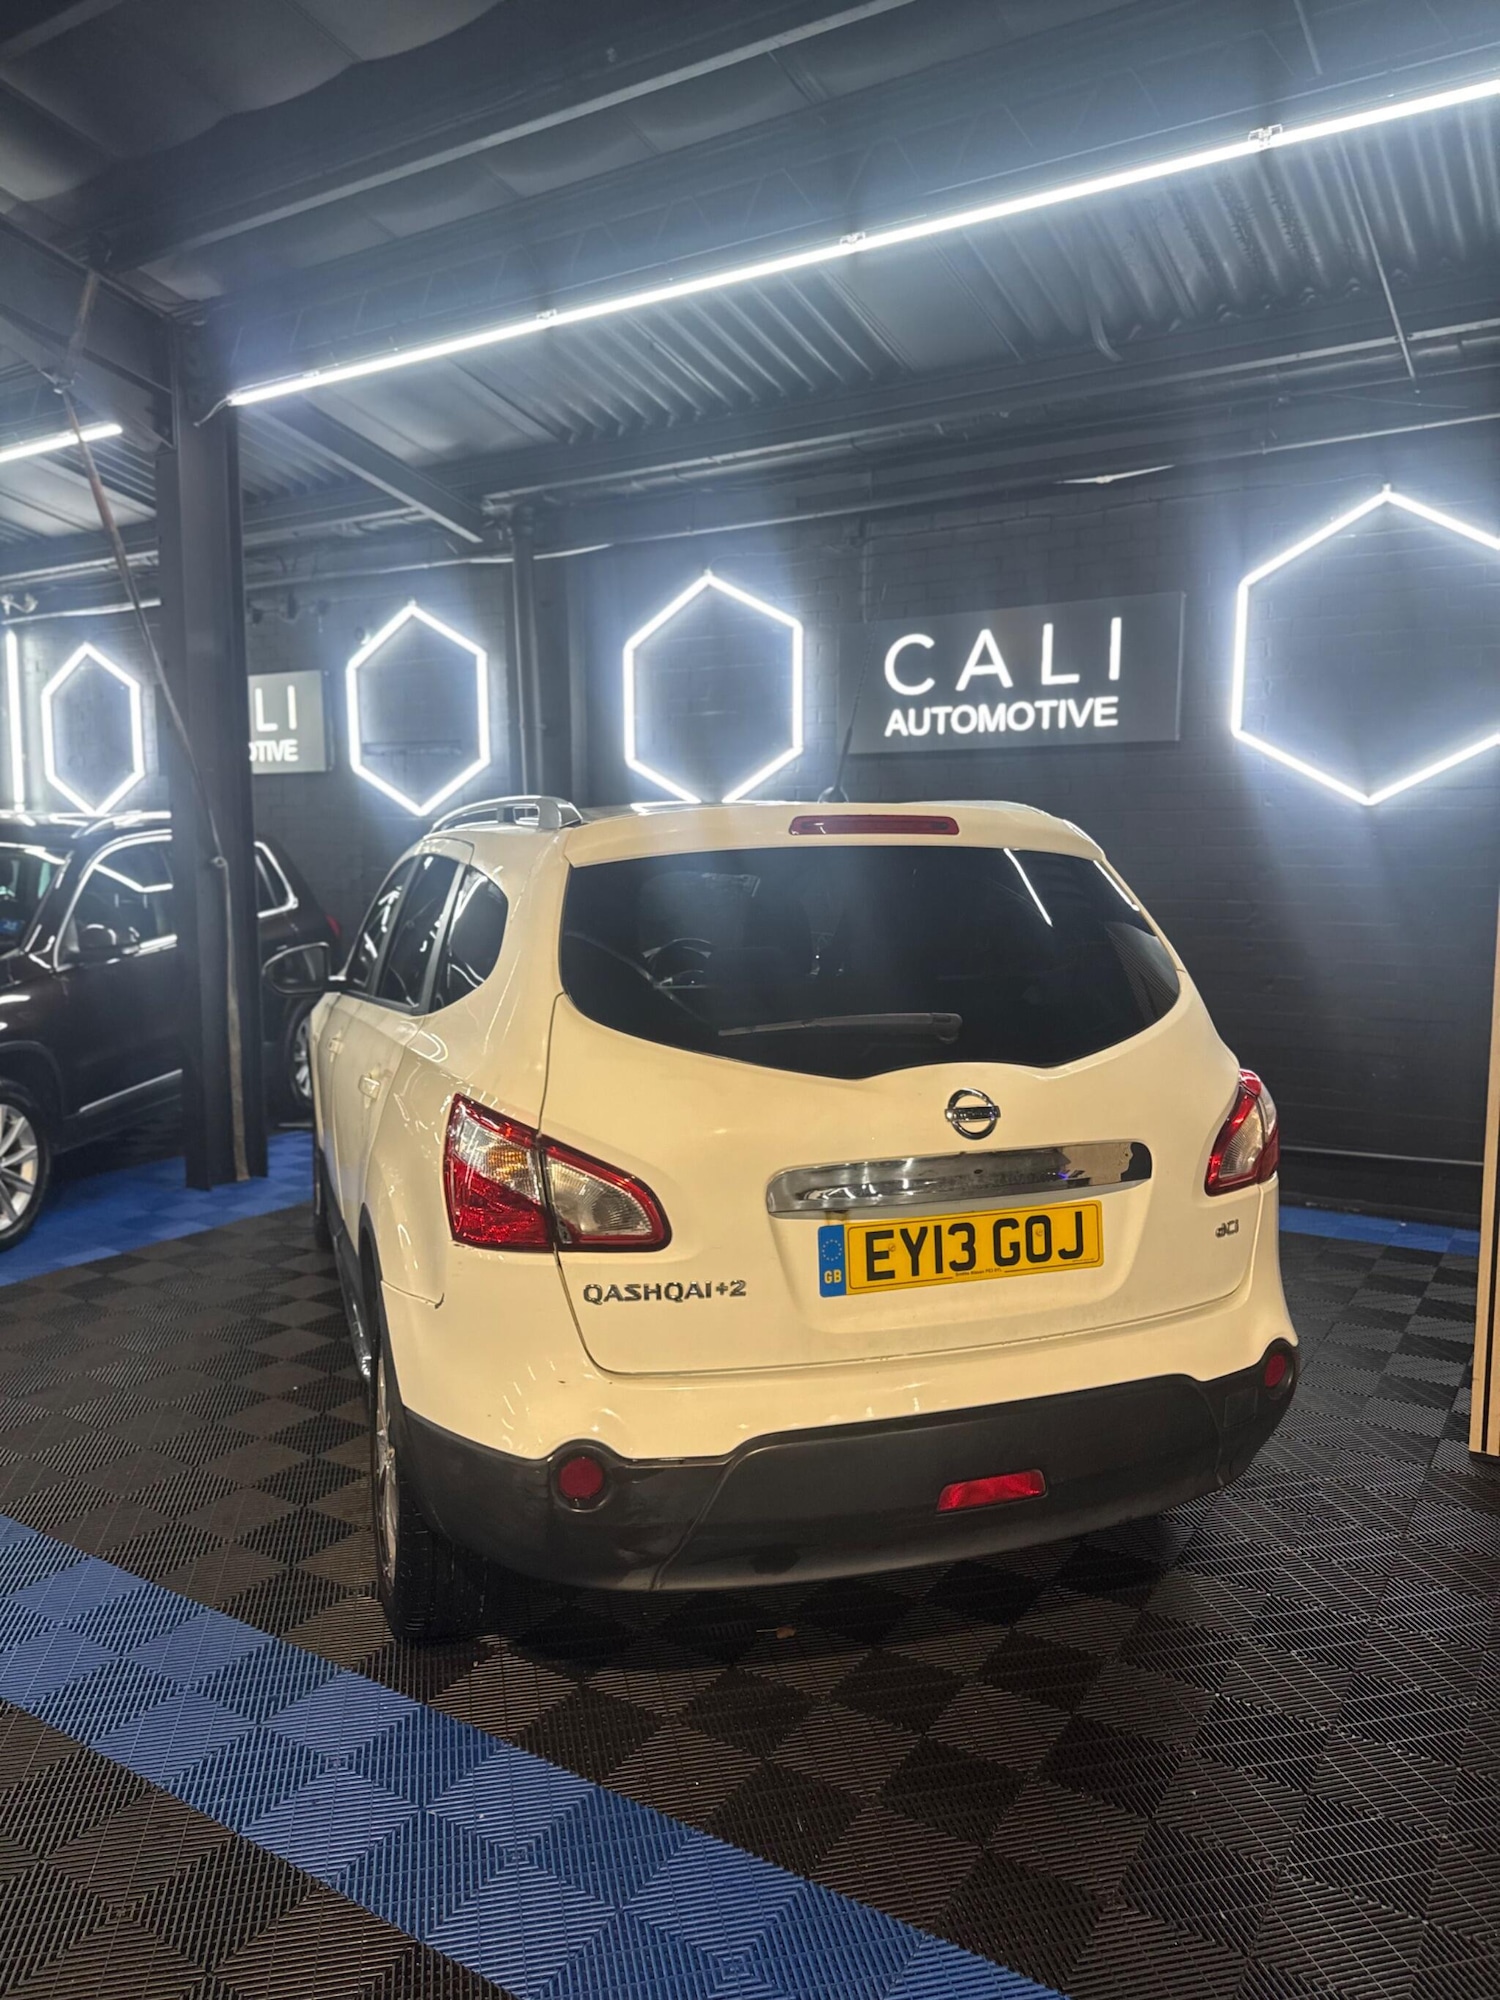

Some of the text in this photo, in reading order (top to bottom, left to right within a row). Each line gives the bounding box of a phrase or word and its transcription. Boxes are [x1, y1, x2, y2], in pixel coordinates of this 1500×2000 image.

[884, 617, 1121, 695] CALI
[884, 696, 1119, 737] AUTOMOTIVE
[865, 1211, 1084, 1282] EY13 GOJ
[583, 1280, 747, 1305] QASHQAI+2
[824, 1269, 842, 1284] GB
